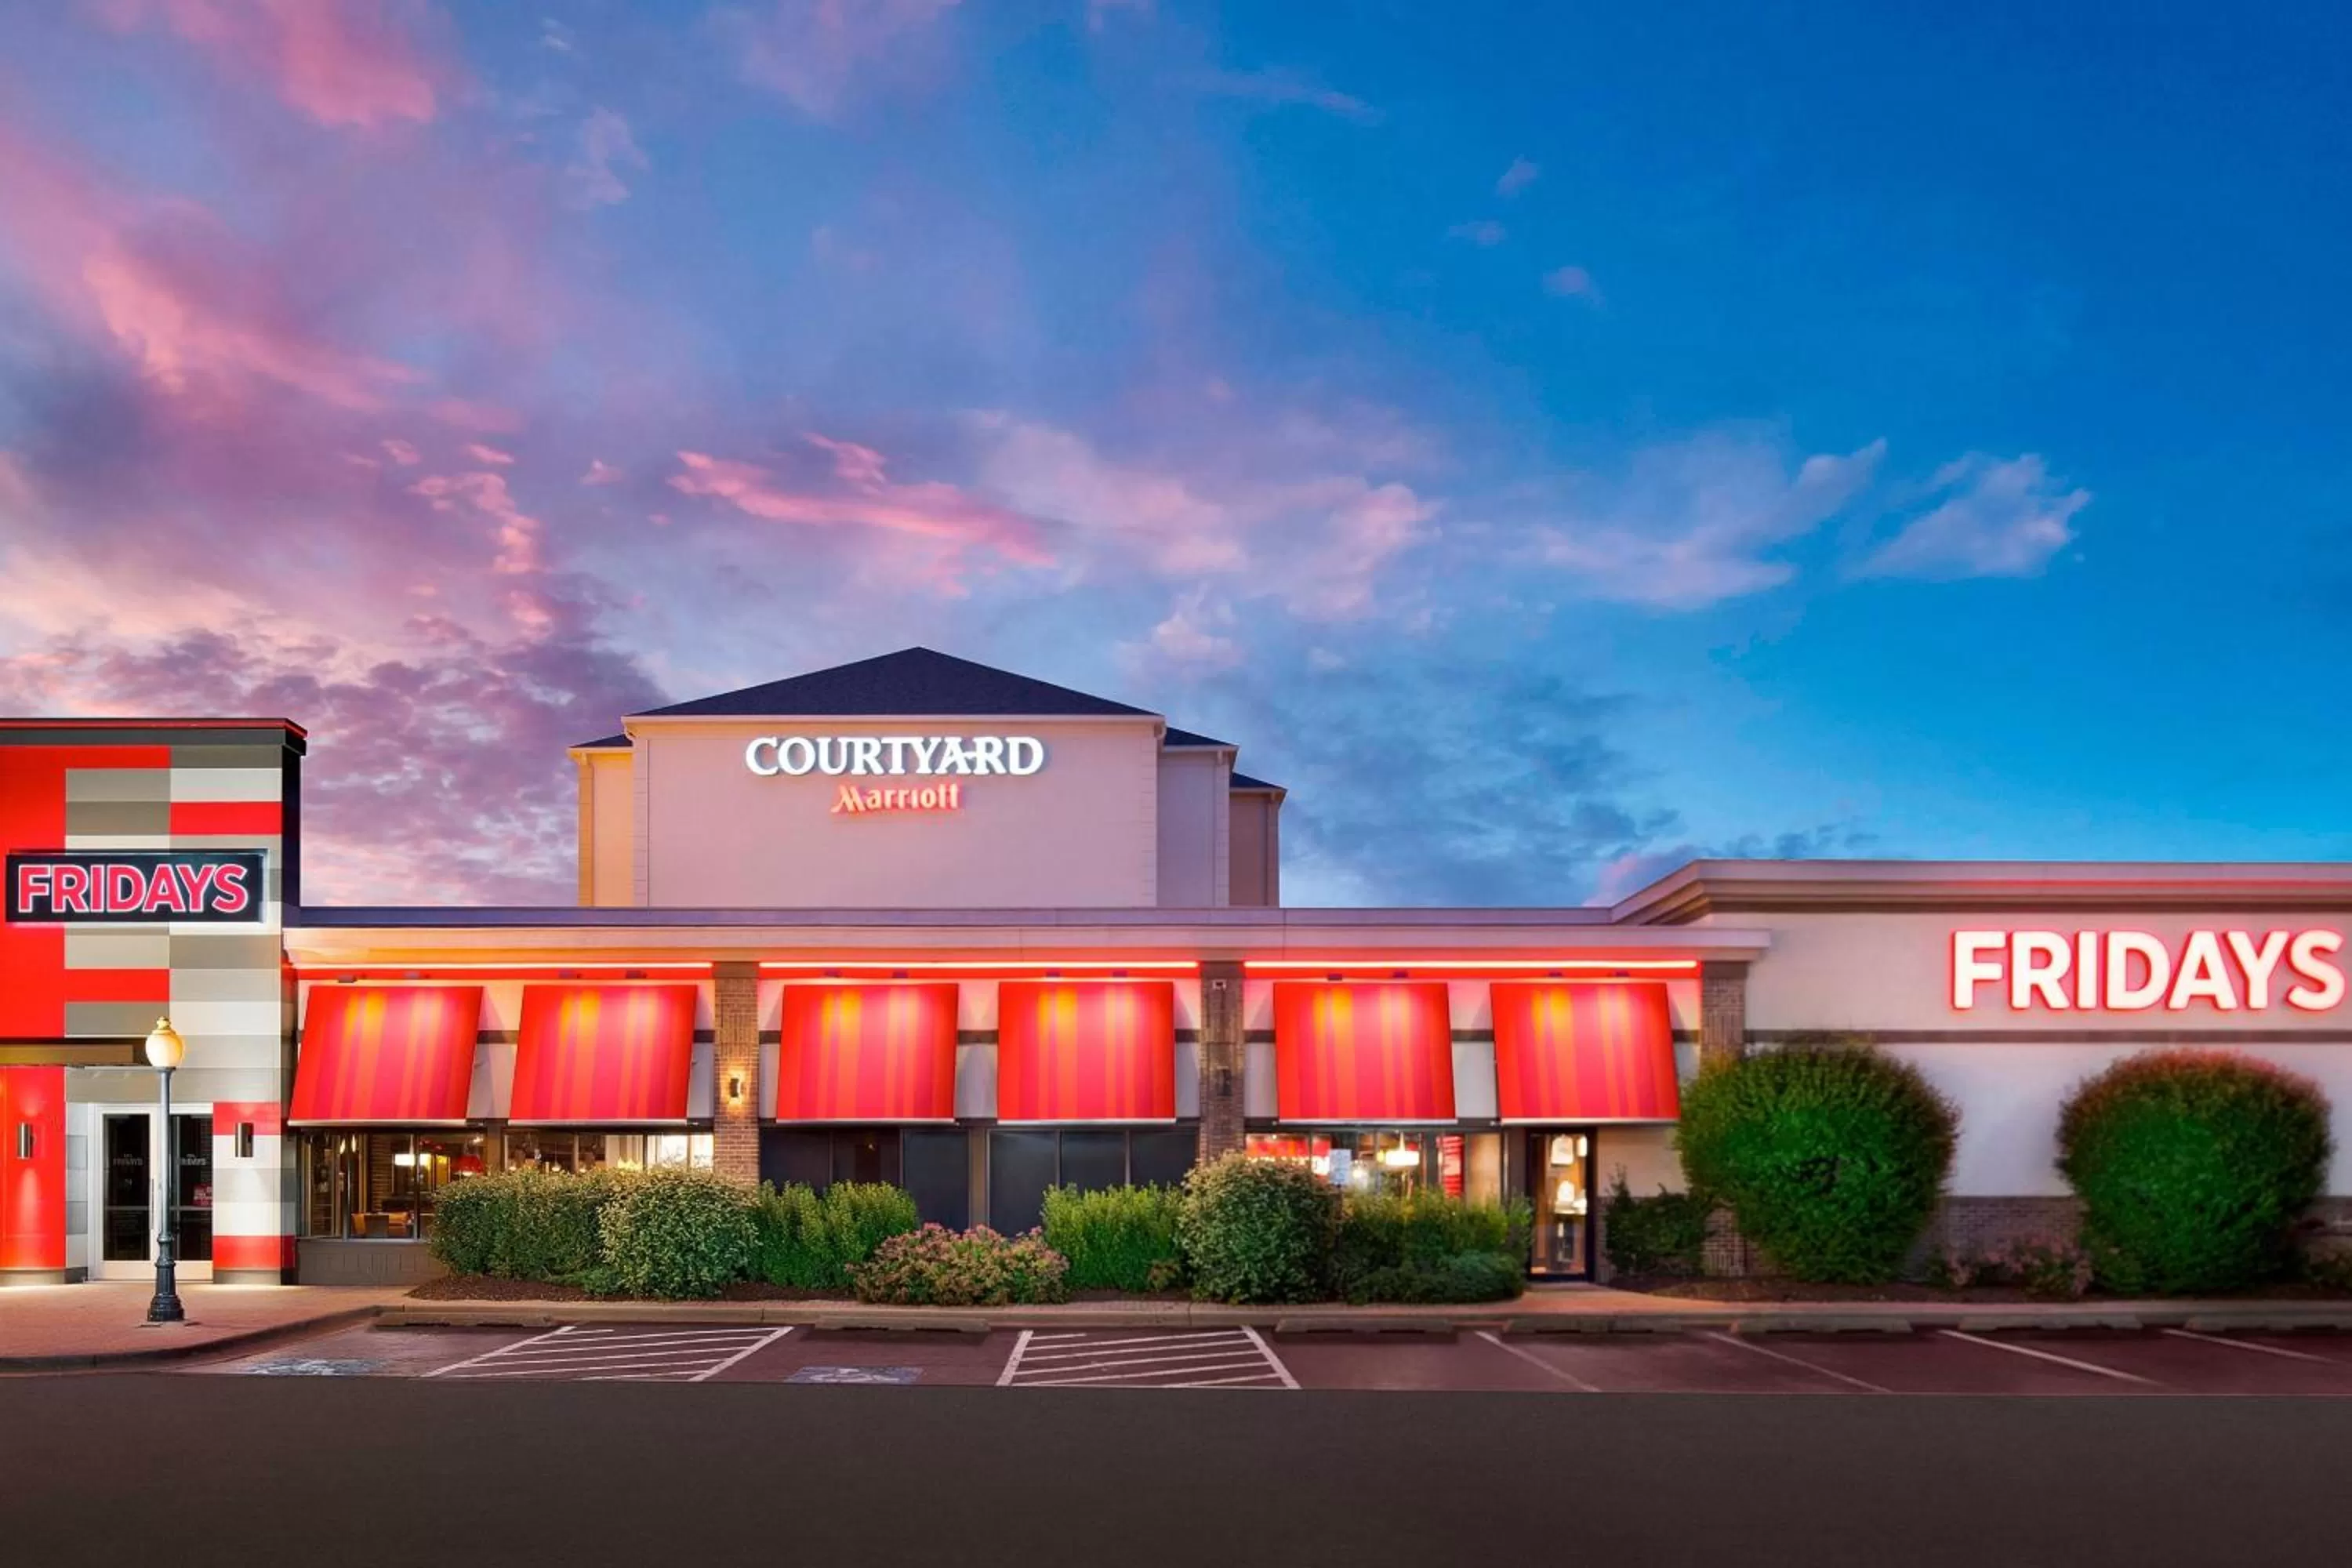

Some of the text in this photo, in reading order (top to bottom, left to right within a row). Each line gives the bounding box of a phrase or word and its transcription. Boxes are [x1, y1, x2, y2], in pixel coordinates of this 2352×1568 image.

[746, 736, 1044, 775] COURTYARD
[830, 784, 959, 813] Marriott
[18, 864, 248, 913] FRIDAYS
[1952, 929, 2345, 1010] FRIDAYS
